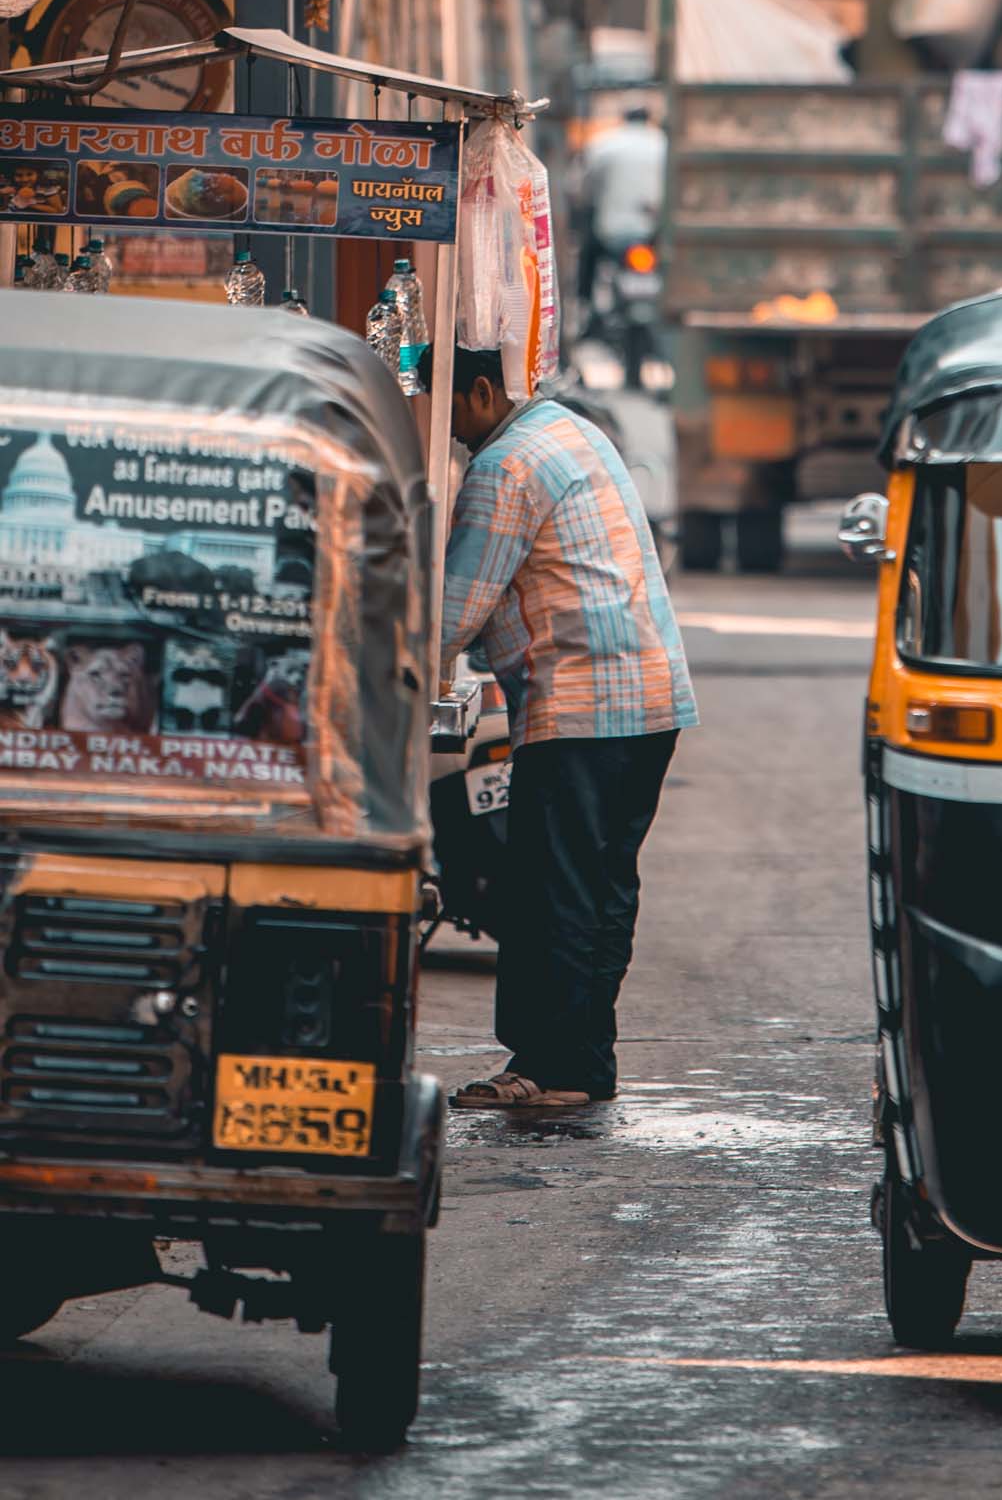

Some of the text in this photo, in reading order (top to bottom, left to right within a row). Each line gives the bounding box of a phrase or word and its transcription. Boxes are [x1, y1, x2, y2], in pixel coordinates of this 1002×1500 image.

[0, 118, 436, 169] अमरनाथ बर्फ गोळा
[352, 176, 444, 202] पायनॅपल
[113, 456, 284, 493] as Entrance gate
[84, 484, 261, 527] Amusement
[161, 739, 298, 764] PRIVATE
[203, 761, 306, 784] NASIK
